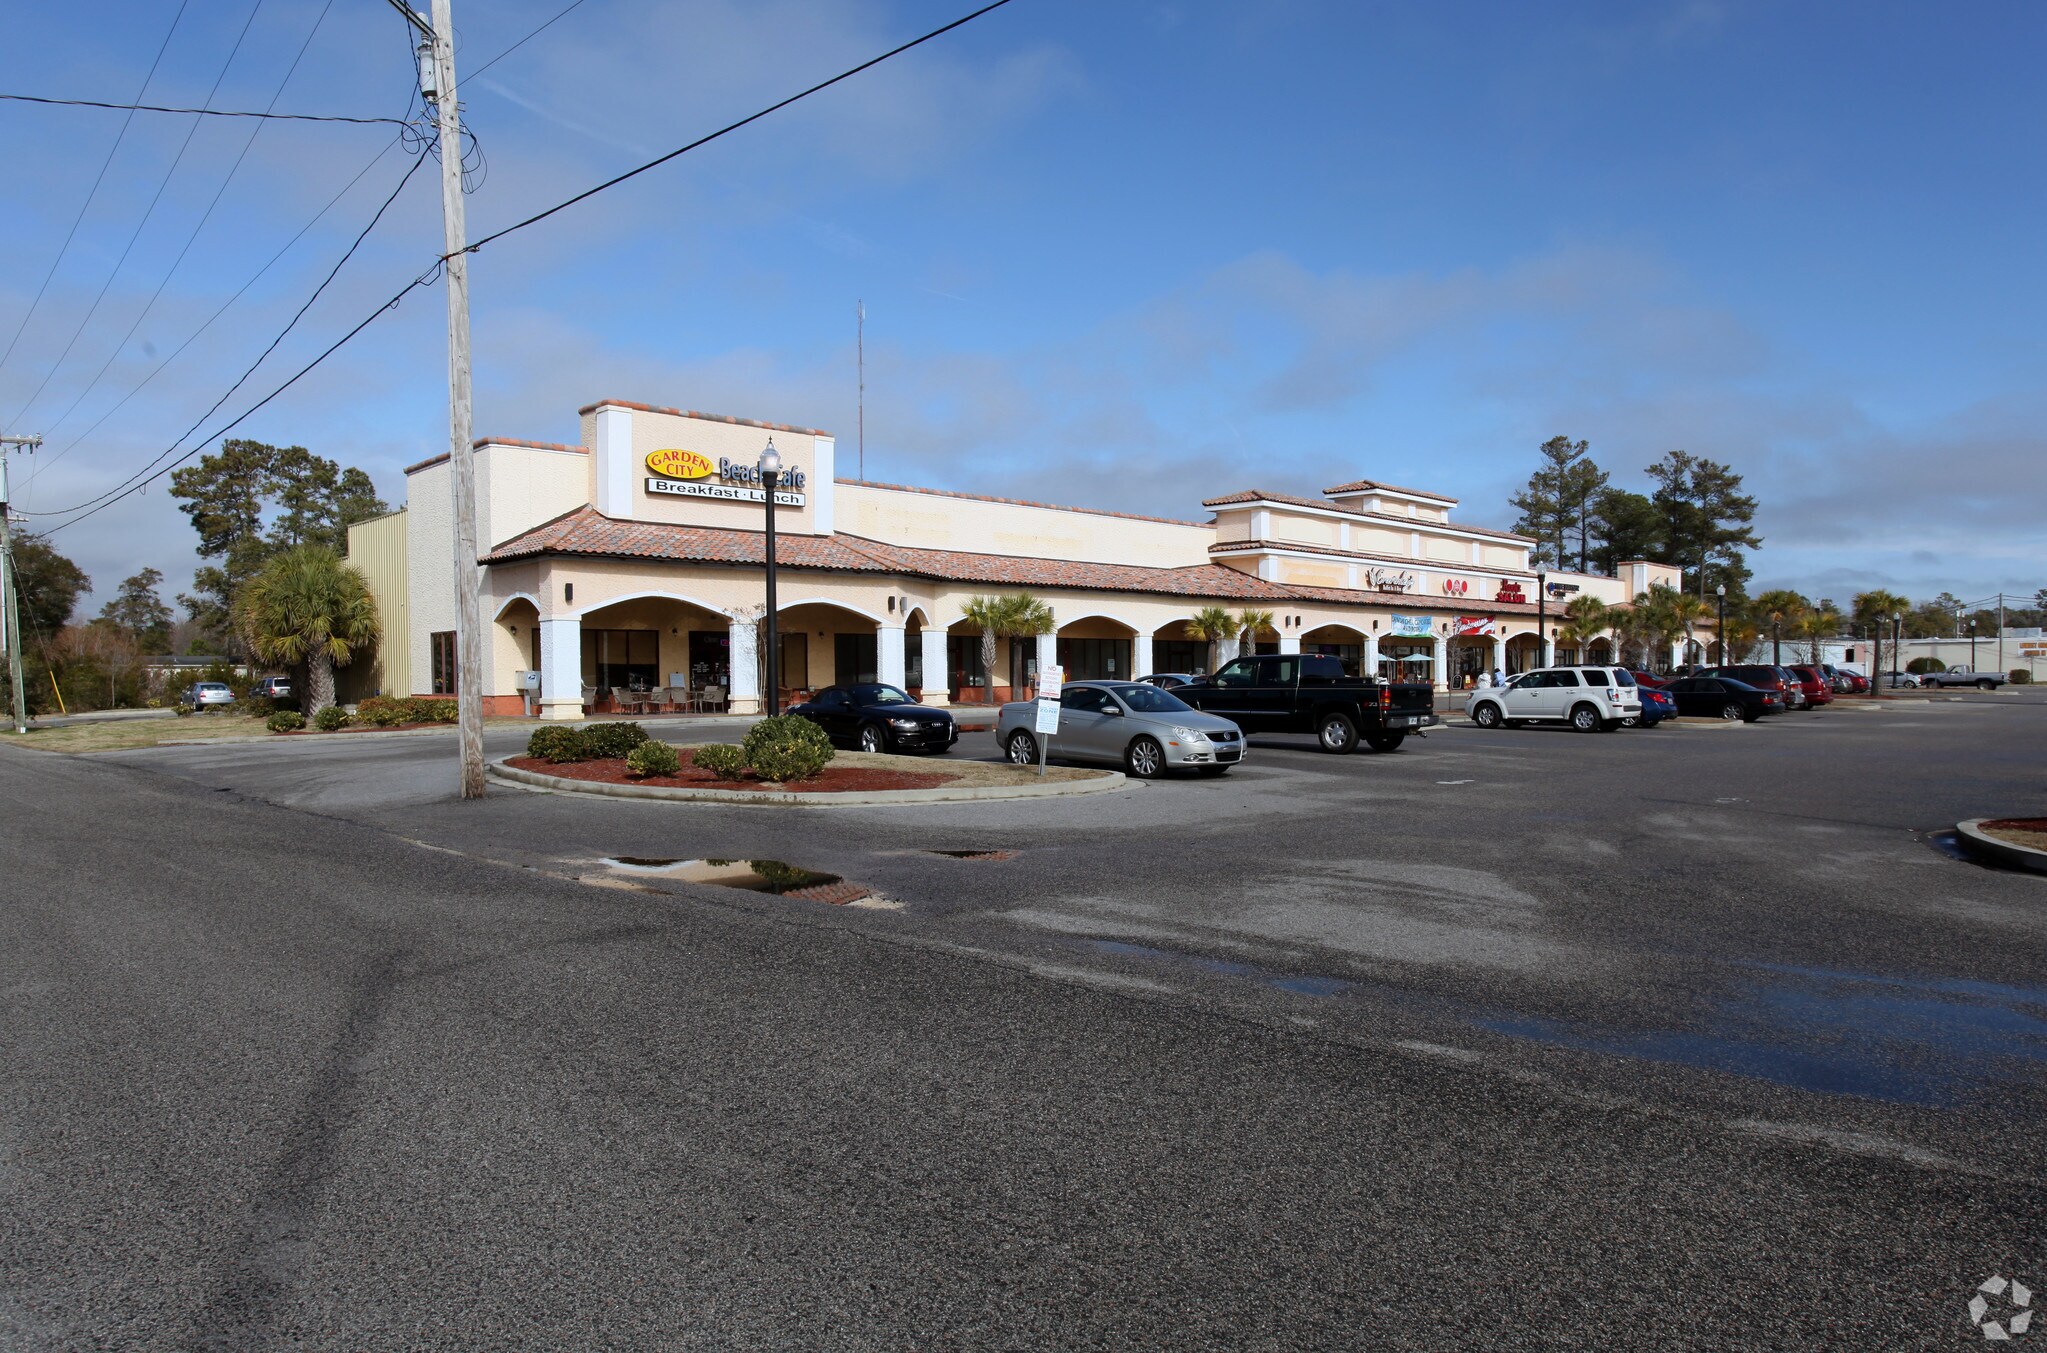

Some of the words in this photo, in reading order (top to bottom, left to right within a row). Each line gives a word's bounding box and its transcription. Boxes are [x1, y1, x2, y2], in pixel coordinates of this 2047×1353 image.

[651, 451, 710, 472] GARDEN
[666, 463, 694, 477] CITY
[656, 481, 740, 499] Breakfast
[1496, 591, 1526, 603] SALON
